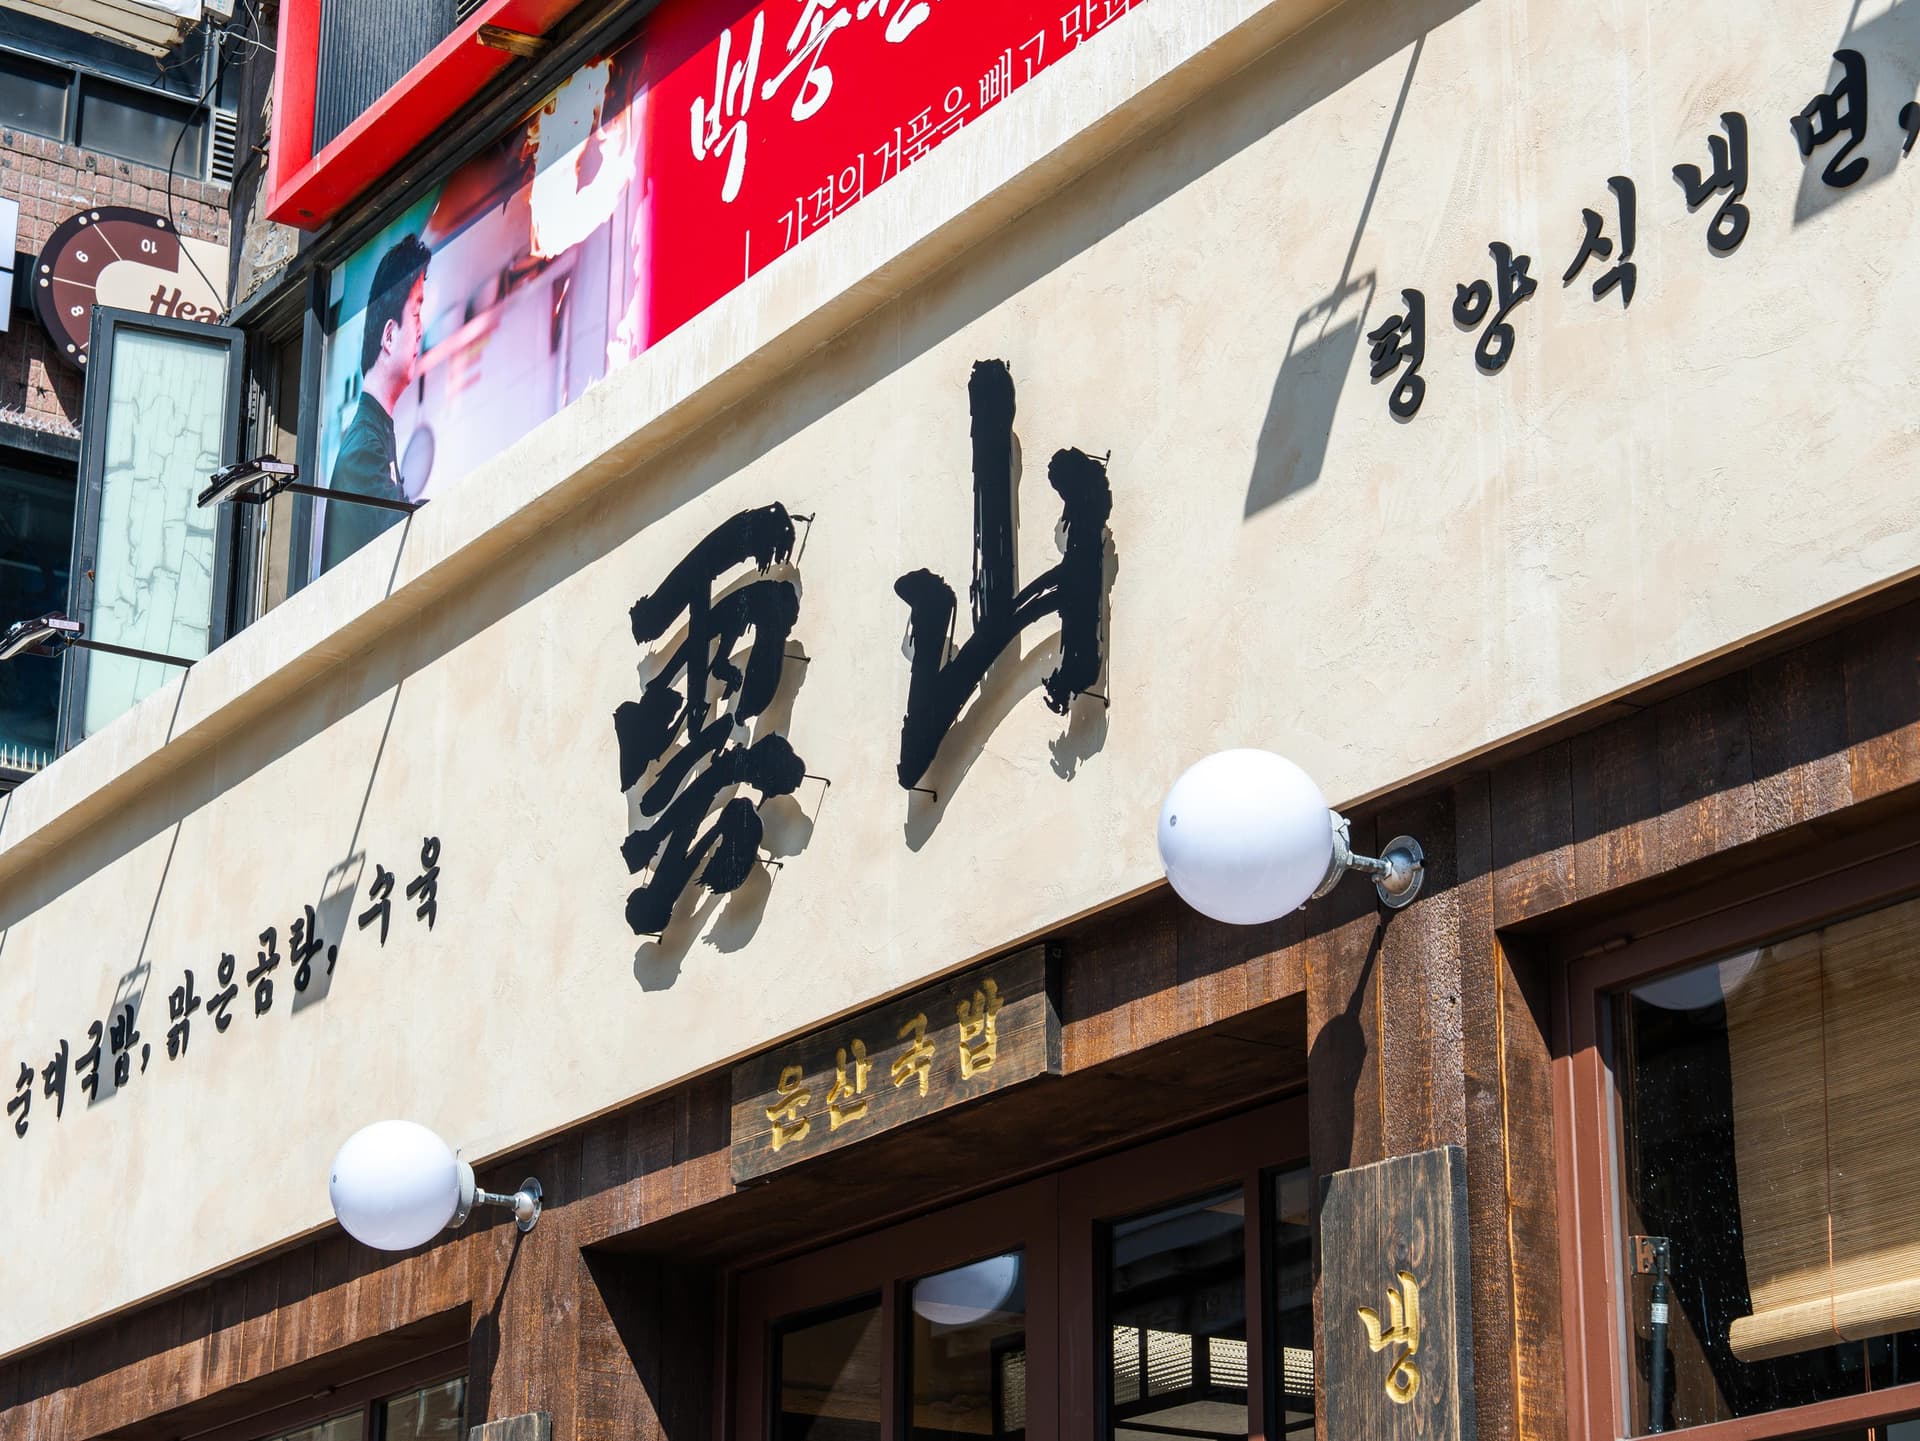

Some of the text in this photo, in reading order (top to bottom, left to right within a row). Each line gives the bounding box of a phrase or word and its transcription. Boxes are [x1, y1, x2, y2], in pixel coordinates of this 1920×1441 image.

[777, 154, 866, 251] 가격의
[70, 304, 85, 317] 8
[358, 836, 442, 946] 수육
[1357, 1270, 1421, 1404] 냉
